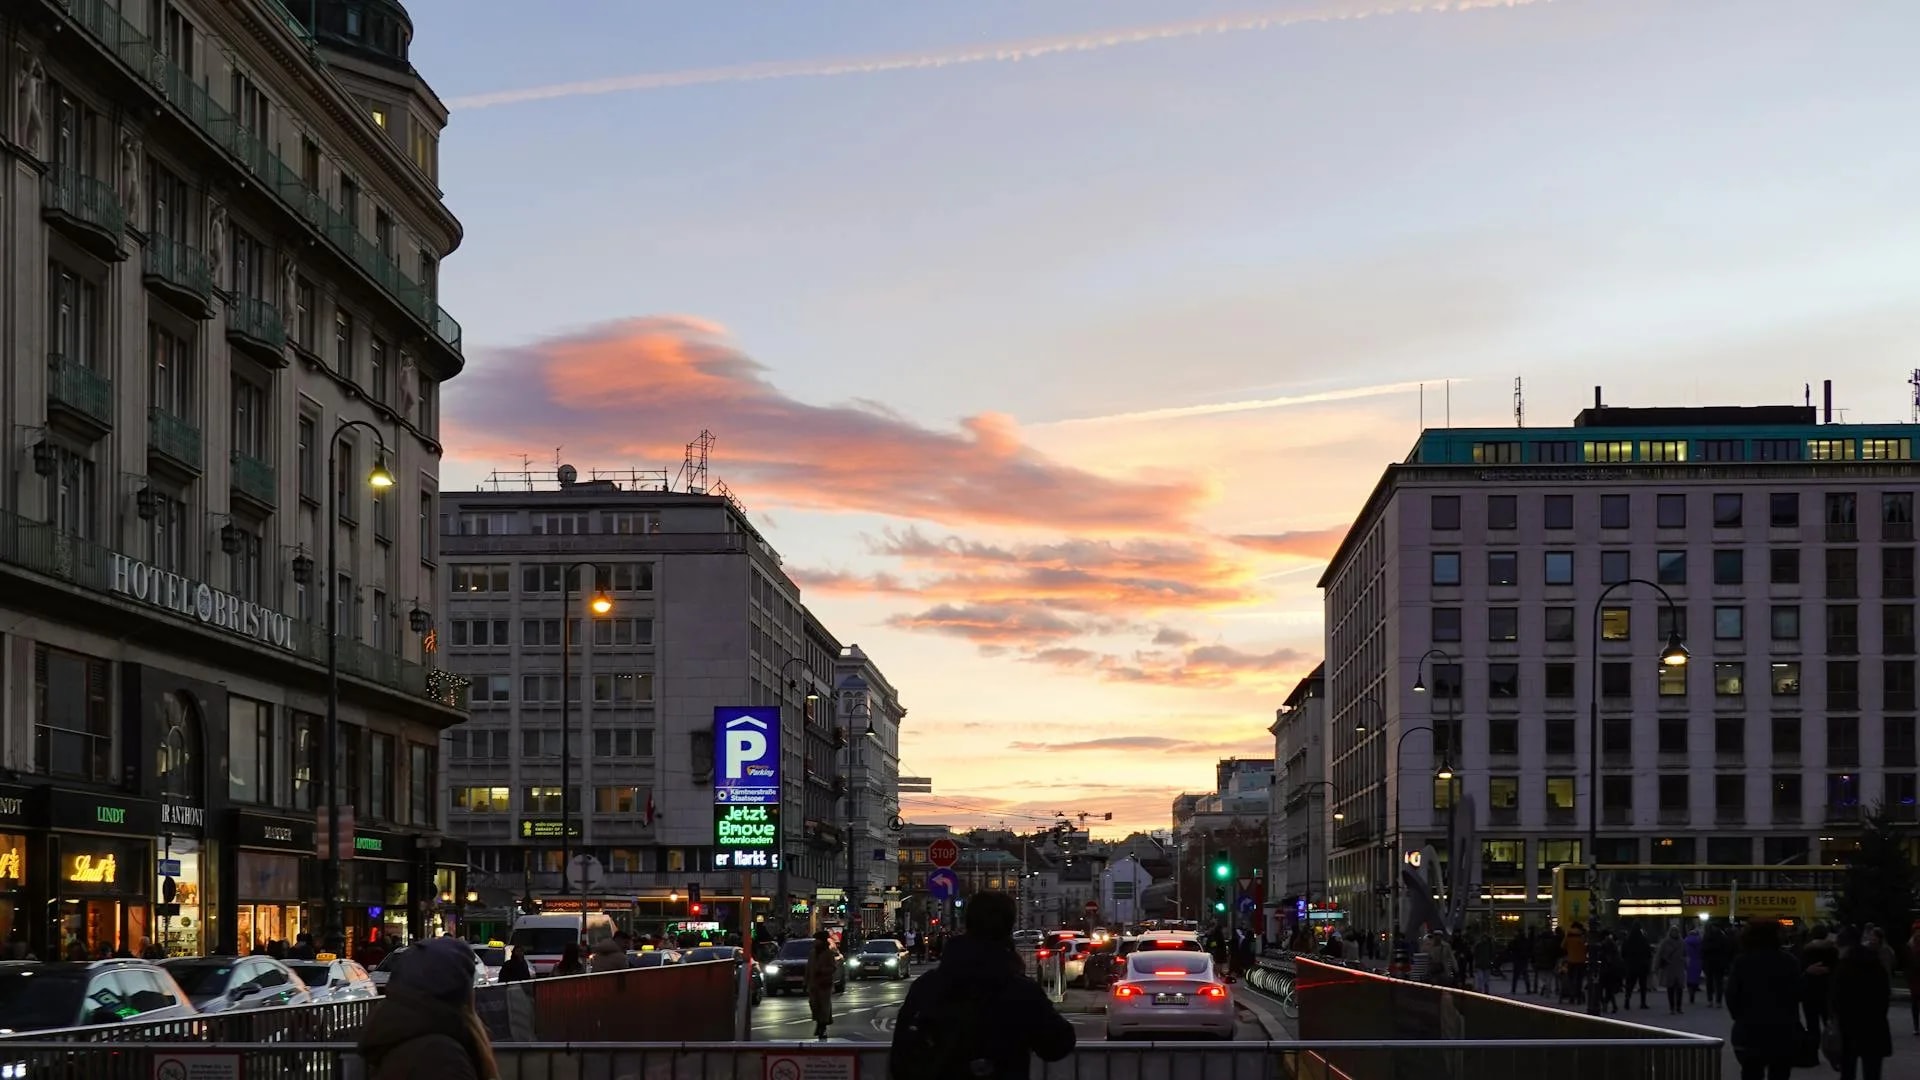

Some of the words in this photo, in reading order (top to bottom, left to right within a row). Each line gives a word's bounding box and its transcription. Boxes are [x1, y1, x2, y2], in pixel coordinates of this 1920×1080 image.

[111, 552, 195, 616] HOTEL
[213, 589, 297, 651] BRISTOL
[726, 730, 768, 779] P
[97, 806, 126, 824] LINDT
[724, 805, 769, 821] Jetzt
[718, 820, 776, 836] Bmove
[719, 835, 774, 844] downloaden
[715, 853, 730, 866] er
[734, 850, 768, 866] Markt
[931, 848, 955, 859] STOP
[1719, 896, 1798, 905] SIHTSEEING
